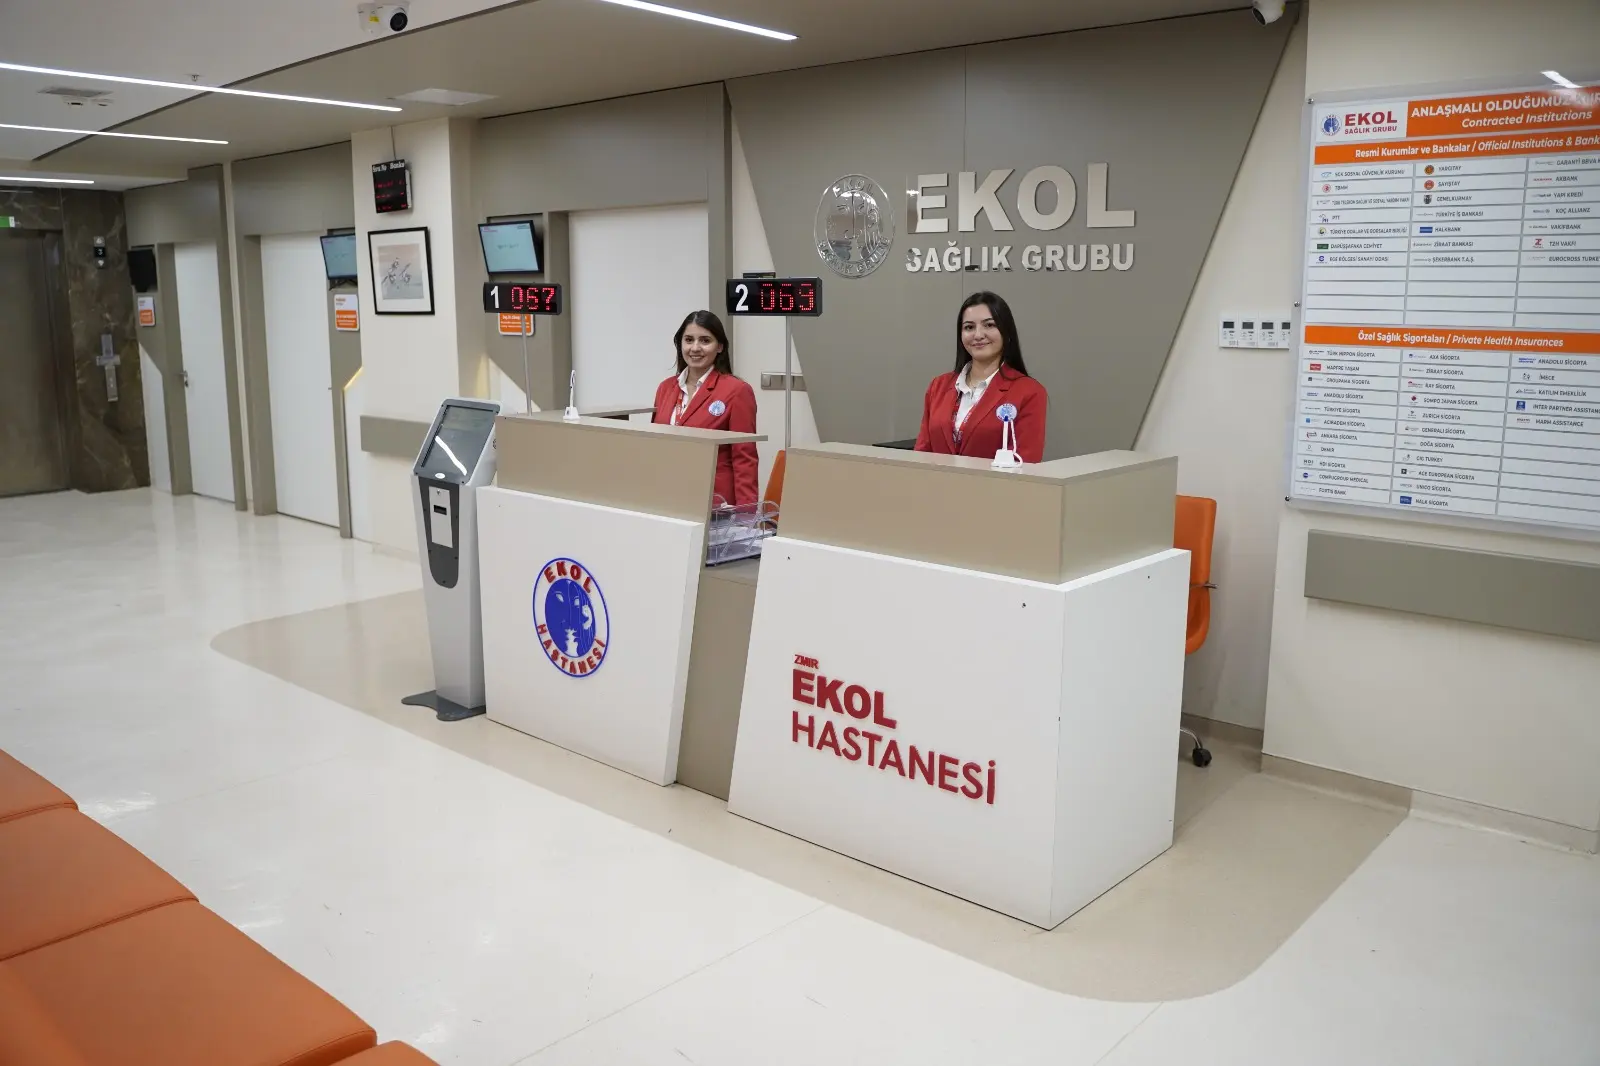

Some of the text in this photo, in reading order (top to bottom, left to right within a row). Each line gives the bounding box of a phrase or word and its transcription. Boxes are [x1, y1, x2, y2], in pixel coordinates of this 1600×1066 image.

[1345, 111, 1397, 126] EKOL
[1412, 102, 1482, 118] ANLAŞMALI
[1462, 110, 1592, 128] Contracted Institutions
[1345, 126, 1370, 134] SAĞLIK
[1356, 148, 1379, 158] Resmi
[1381, 145, 1418, 156] Kurumlar
[1432, 142, 1470, 153] Bankalar
[1472, 141, 1476, 152] /
[1478, 140, 1510, 150] Official
[1512, 137, 1563, 149] Institutions
[1566, 138, 1572, 146] &
[833, 179, 873, 197] EKOL
[907, 162, 1135, 234] EKOL
[906, 241, 1134, 272] SAĞLIK GRUBU
[490, 286, 499, 308] 1
[735, 284, 813, 311] 2 069
[1358, 330, 1563, 347] Özel Sağlık Sigortaları / Private Health Insurances
[544, 561, 591, 593] EKOL
[793, 669, 897, 729] EKOL
[792, 711, 996, 805] HASTANESİ
